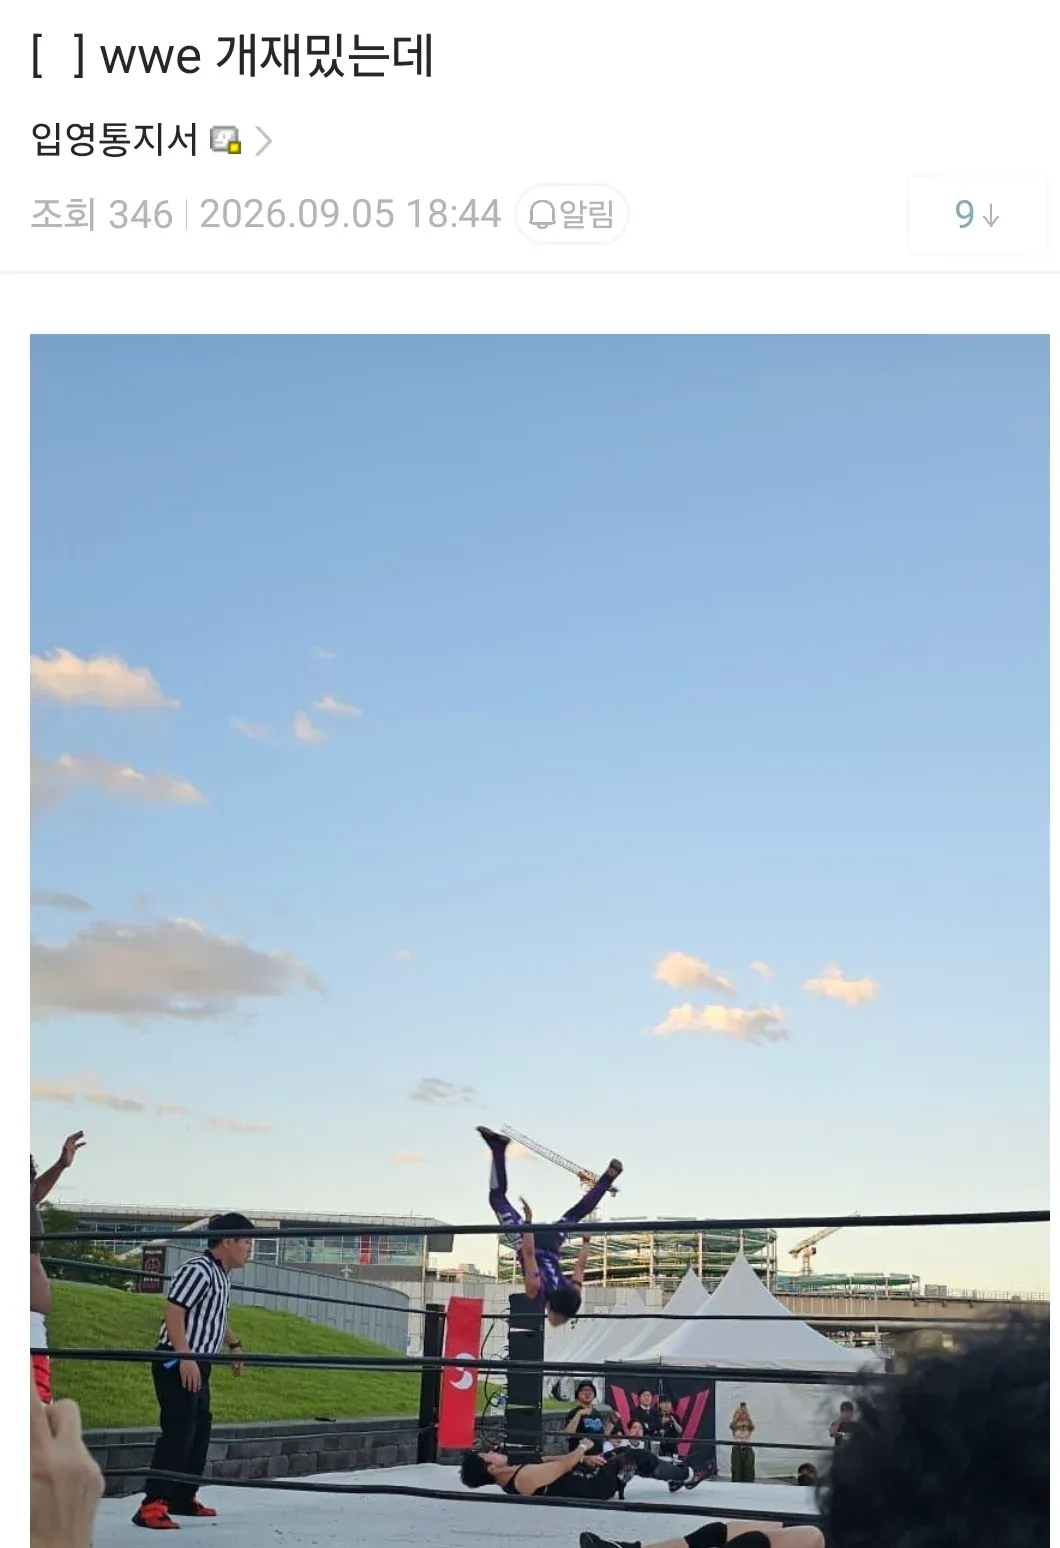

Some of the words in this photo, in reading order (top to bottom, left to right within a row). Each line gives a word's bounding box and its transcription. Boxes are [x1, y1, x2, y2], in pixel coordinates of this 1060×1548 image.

[99, 44, 201, 75] wwe
[216, 33, 432, 78] 개재밌는데
[31, 122, 197, 158] 입영통지서
[30, 197, 94, 232] 조회
[109, 199, 173, 229] 346
[200, 198, 394, 228] 2026.09.05
[407, 198, 502, 228] 18:44
[559, 200, 614, 230] 알림
[955, 199, 975, 229] 9
